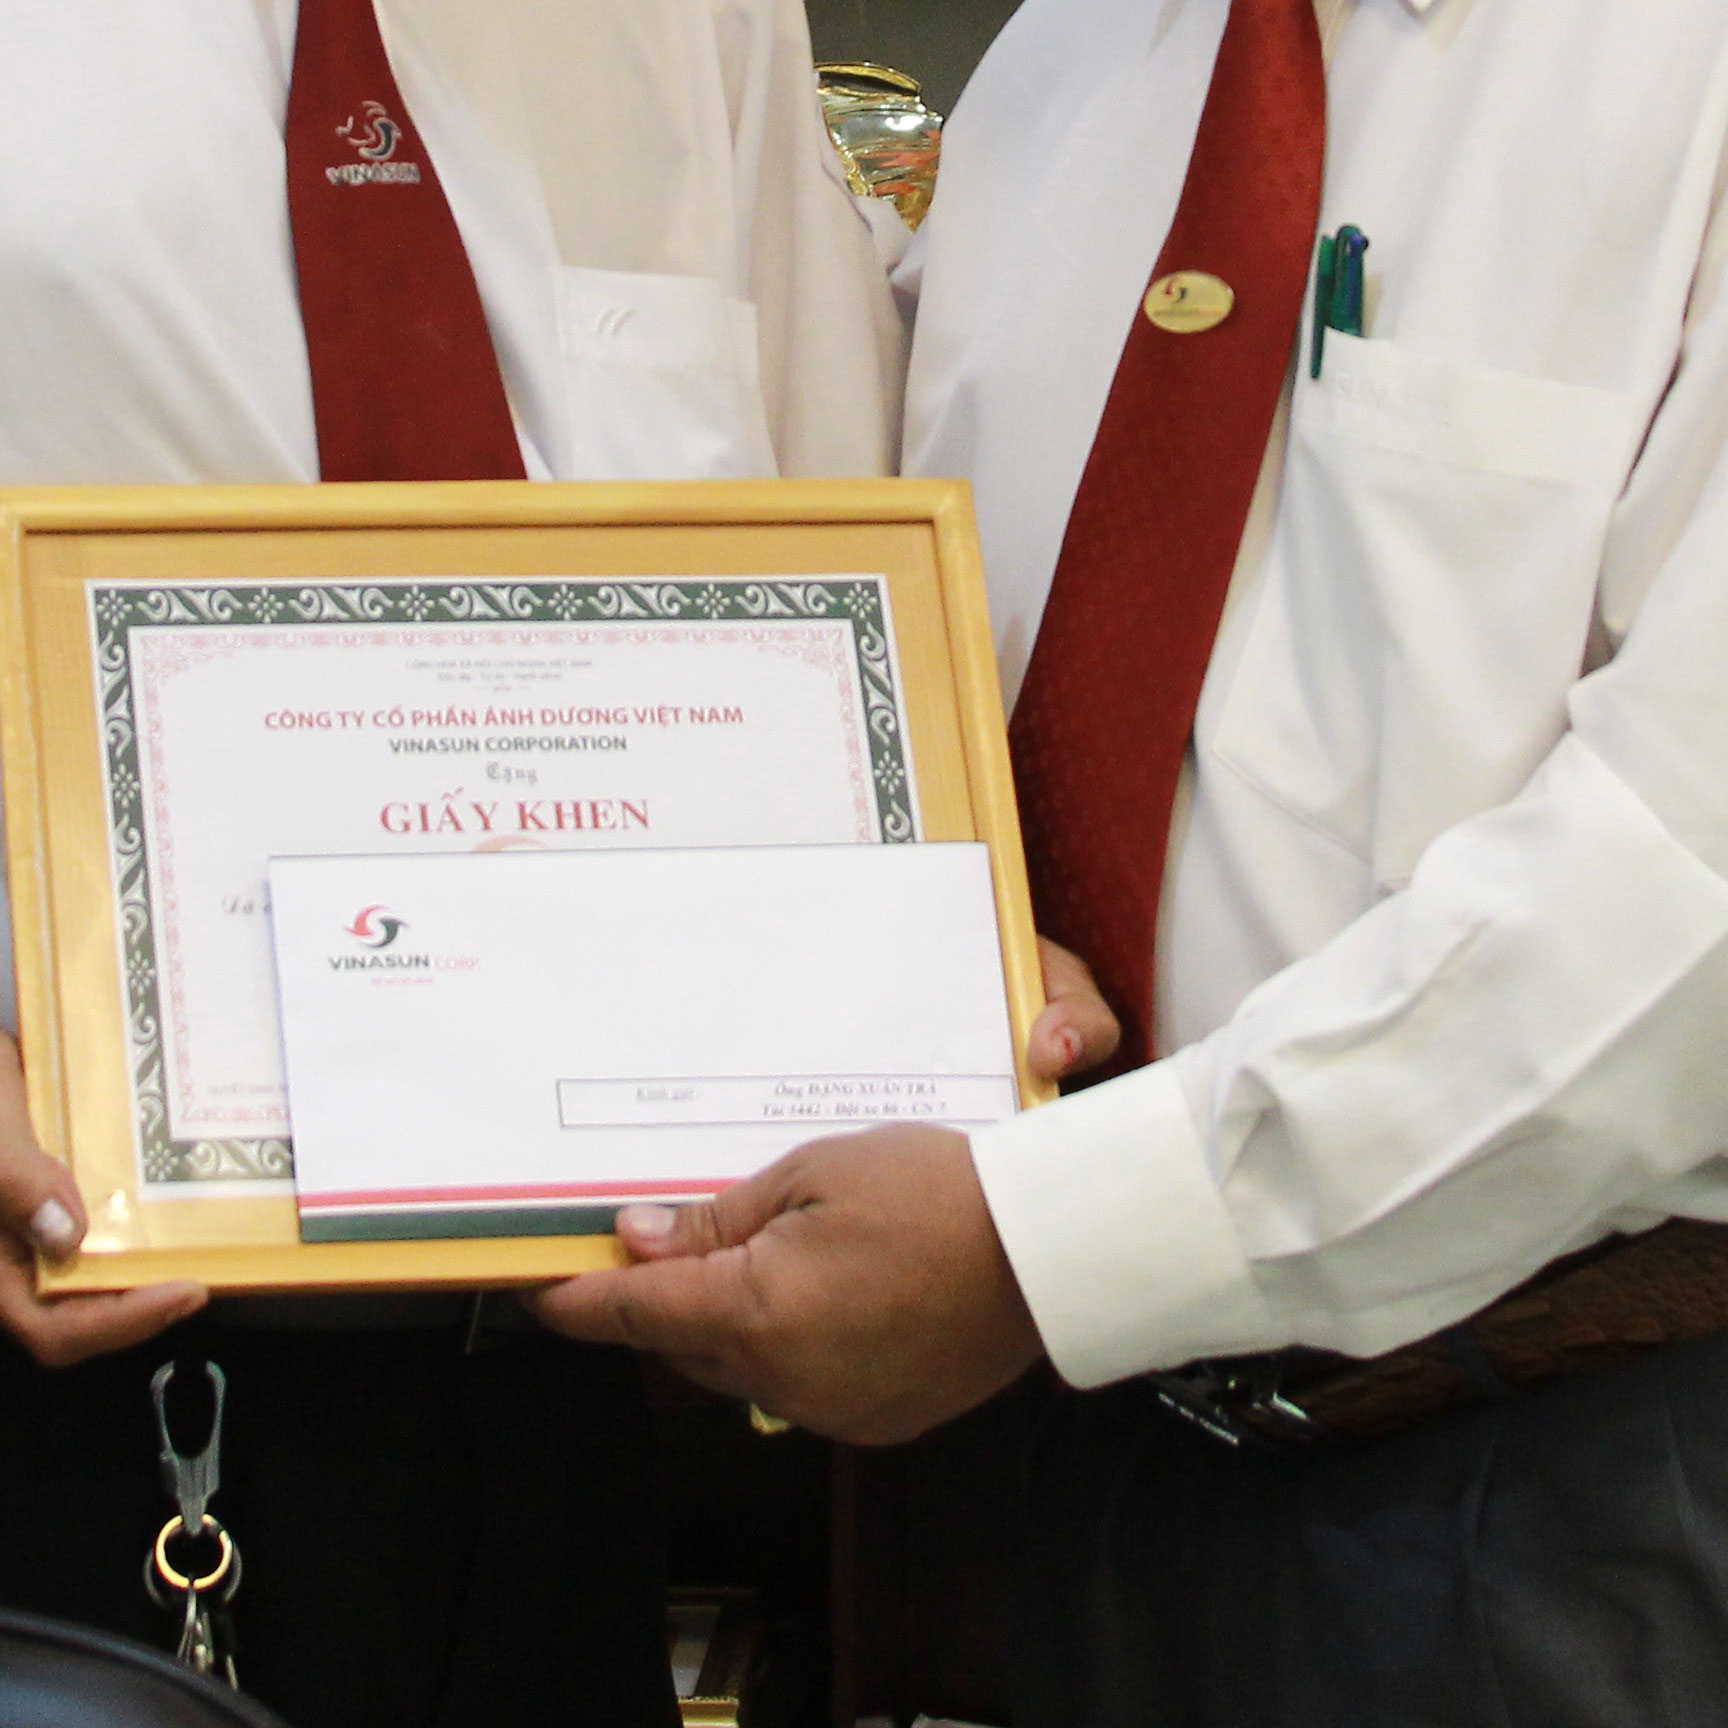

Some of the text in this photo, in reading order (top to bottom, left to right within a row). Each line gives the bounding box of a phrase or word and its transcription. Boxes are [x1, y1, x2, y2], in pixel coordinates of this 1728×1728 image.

[265, 709, 332, 730] CÔNG
[337, 709, 365, 728] TY
[373, 703, 406, 728] CỔ
[413, 704, 478, 728] PHẦN
[541, 705, 629, 727] DƯƠNG
[635, 703, 682, 729] VIỆT
[690, 705, 745, 725] NAM
[390, 734, 628, 754] VINASUN CORPORATION
[380, 787, 651, 834] GIẤY KHEN
[328, 954, 430, 970] VINASUN
